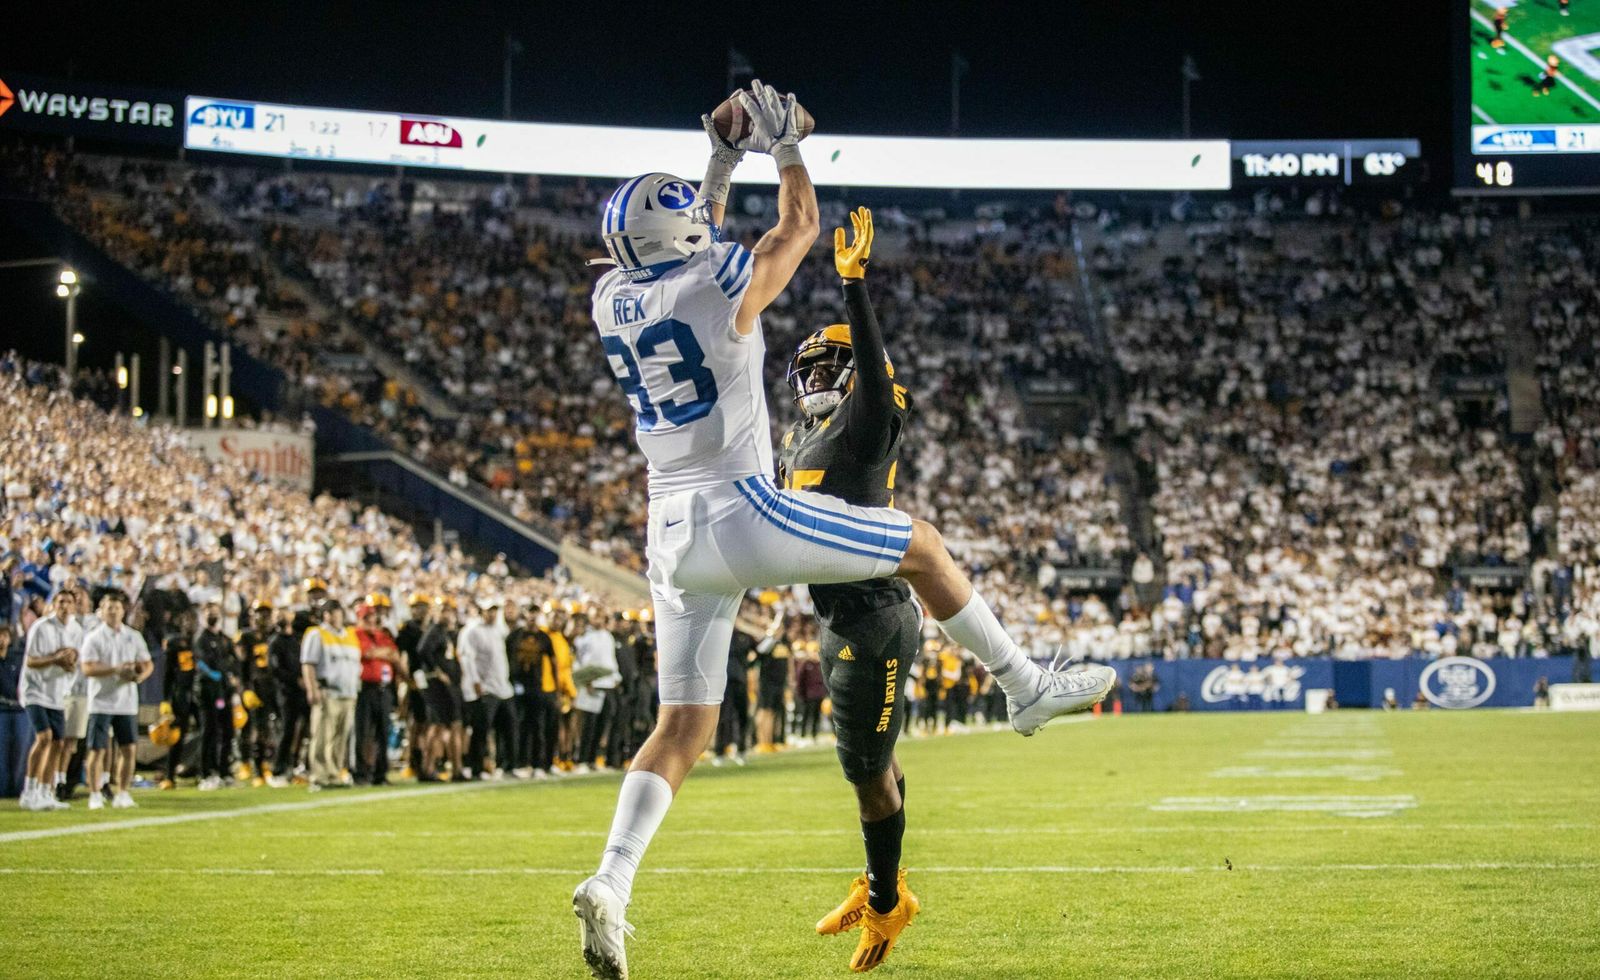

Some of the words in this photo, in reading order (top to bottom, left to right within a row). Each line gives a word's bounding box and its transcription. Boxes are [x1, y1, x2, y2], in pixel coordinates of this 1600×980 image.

[17, 88, 174, 127] WAYSTAR
[195, 105, 247, 131] BYU
[264, 112, 286, 132] 21
[408, 123, 453, 145] ASU
[1243, 152, 1300, 177] 11:40
[1301, 152, 1340, 177] PM
[1476, 160, 1513, 186] 40
[660, 182, 690, 206] Y
[613, 293, 646, 326] REX
[884, 658, 898, 705] DEVILS
[876, 706, 893, 733] SUN
